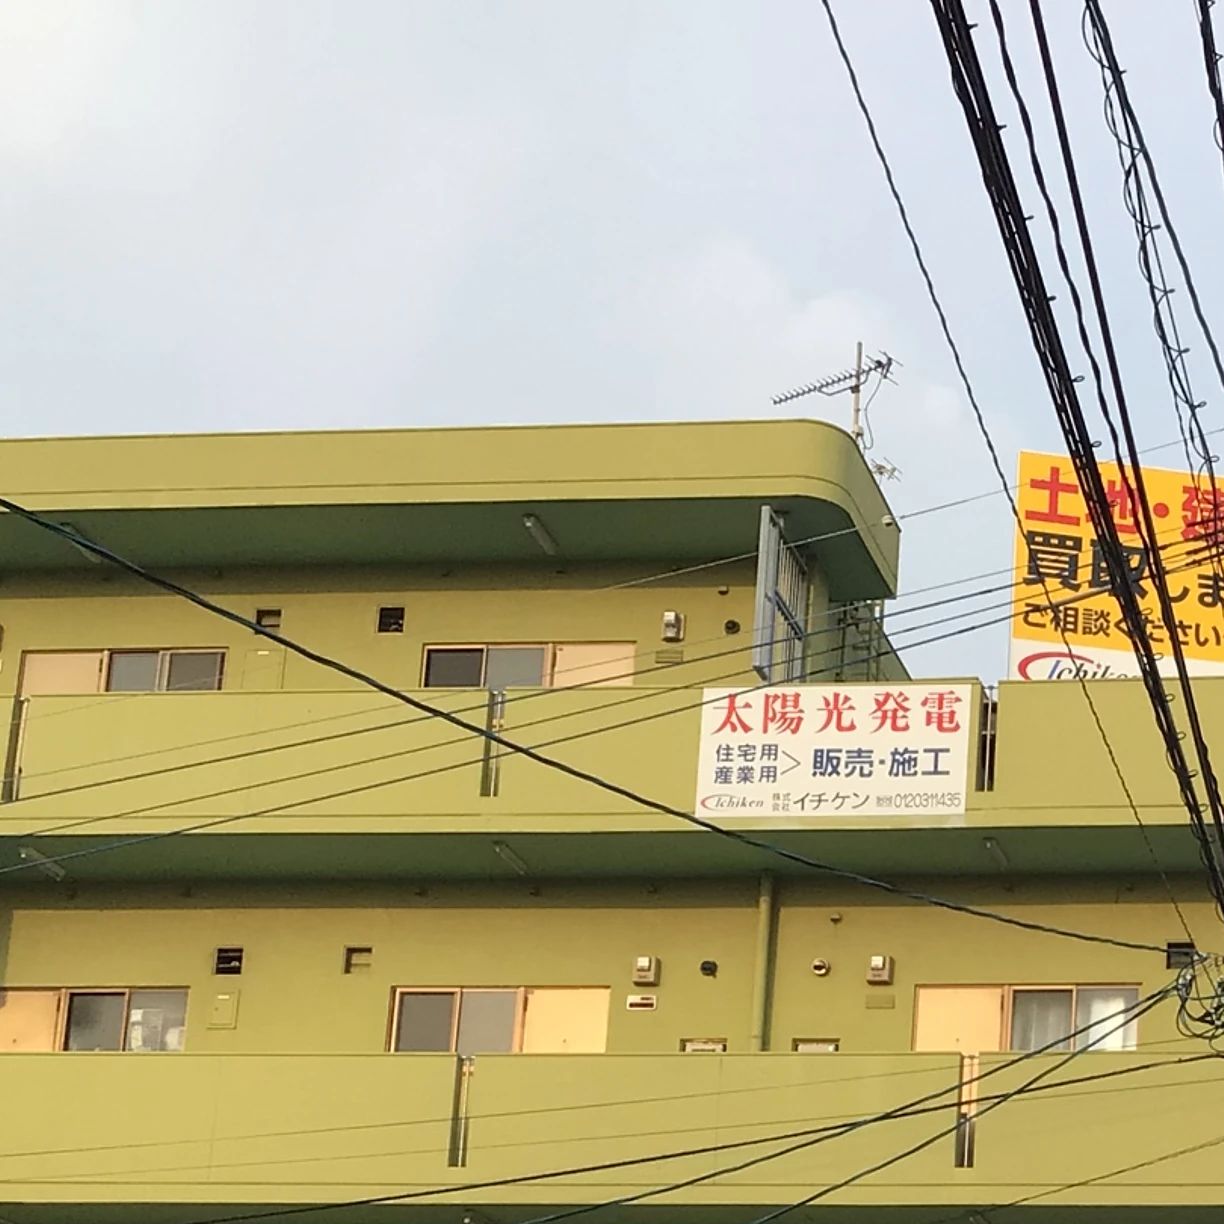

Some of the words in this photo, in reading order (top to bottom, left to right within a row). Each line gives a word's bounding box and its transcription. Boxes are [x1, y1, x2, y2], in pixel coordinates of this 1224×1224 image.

[711, 690, 963, 735] 太陽光発電
[715, 744, 778, 762] 住宅用
[811, 747, 951, 778] 販売・施工
[714, 766, 777, 784] 産業用
[714, 795, 764, 809] Ichiken
[793, 792, 870, 811] イチケン
